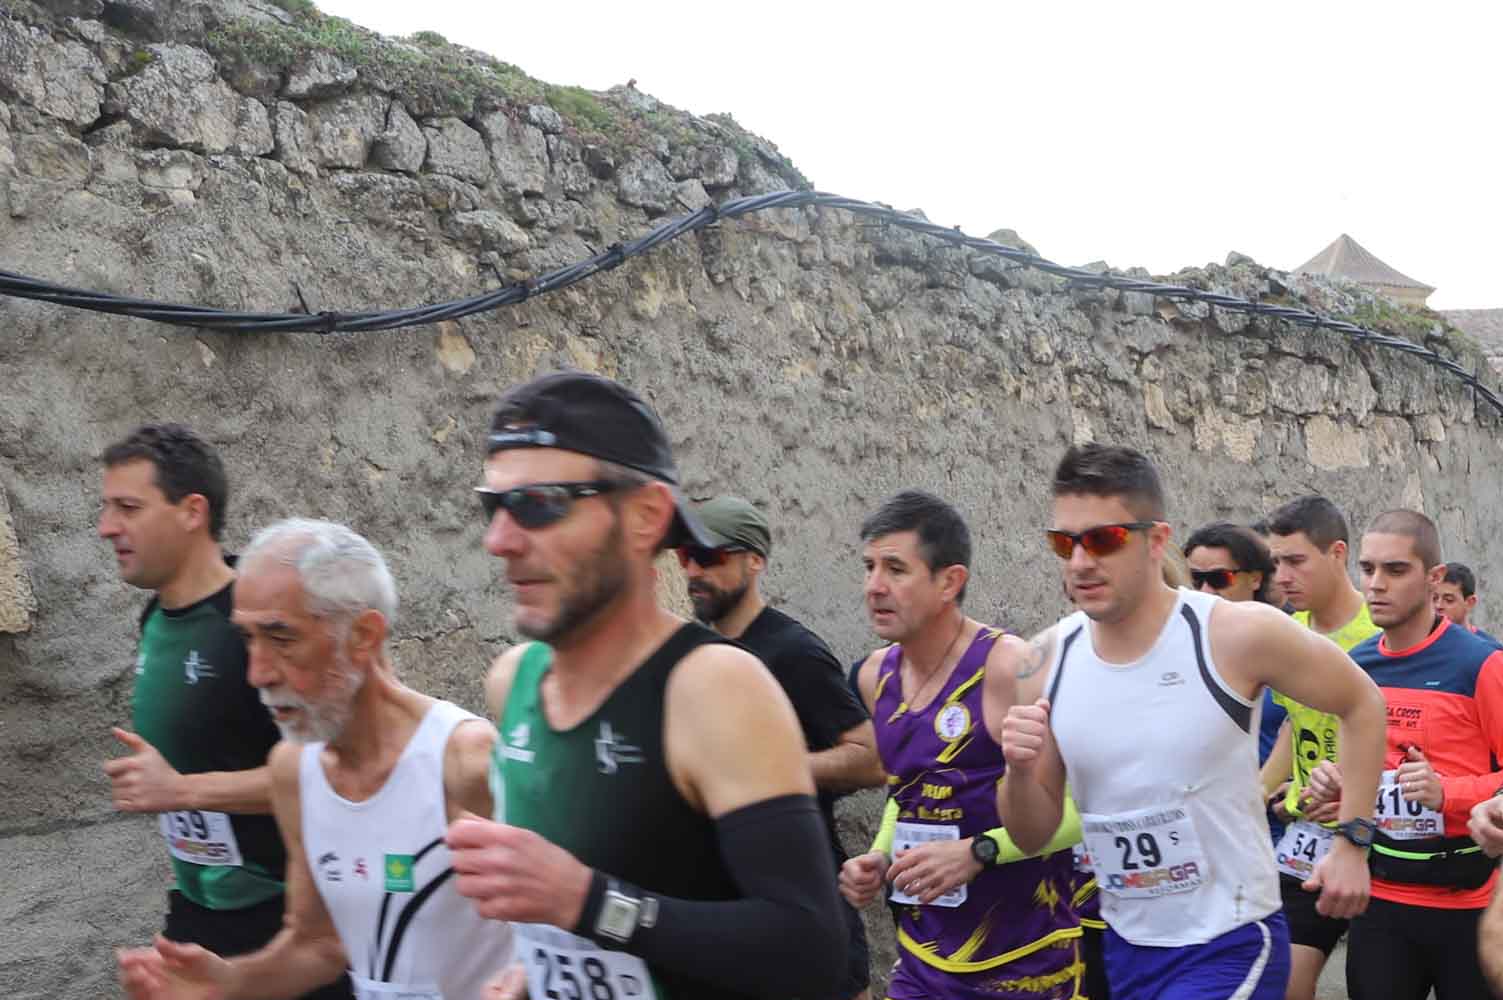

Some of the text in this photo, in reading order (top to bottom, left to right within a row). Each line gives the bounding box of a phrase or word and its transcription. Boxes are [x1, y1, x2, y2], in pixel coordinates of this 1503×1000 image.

[1396, 708, 1422, 719] CROSS
[1323, 728, 1337, 761] ARIO
[1114, 832, 1163, 871] 29
[1293, 832, 1318, 862] 54
